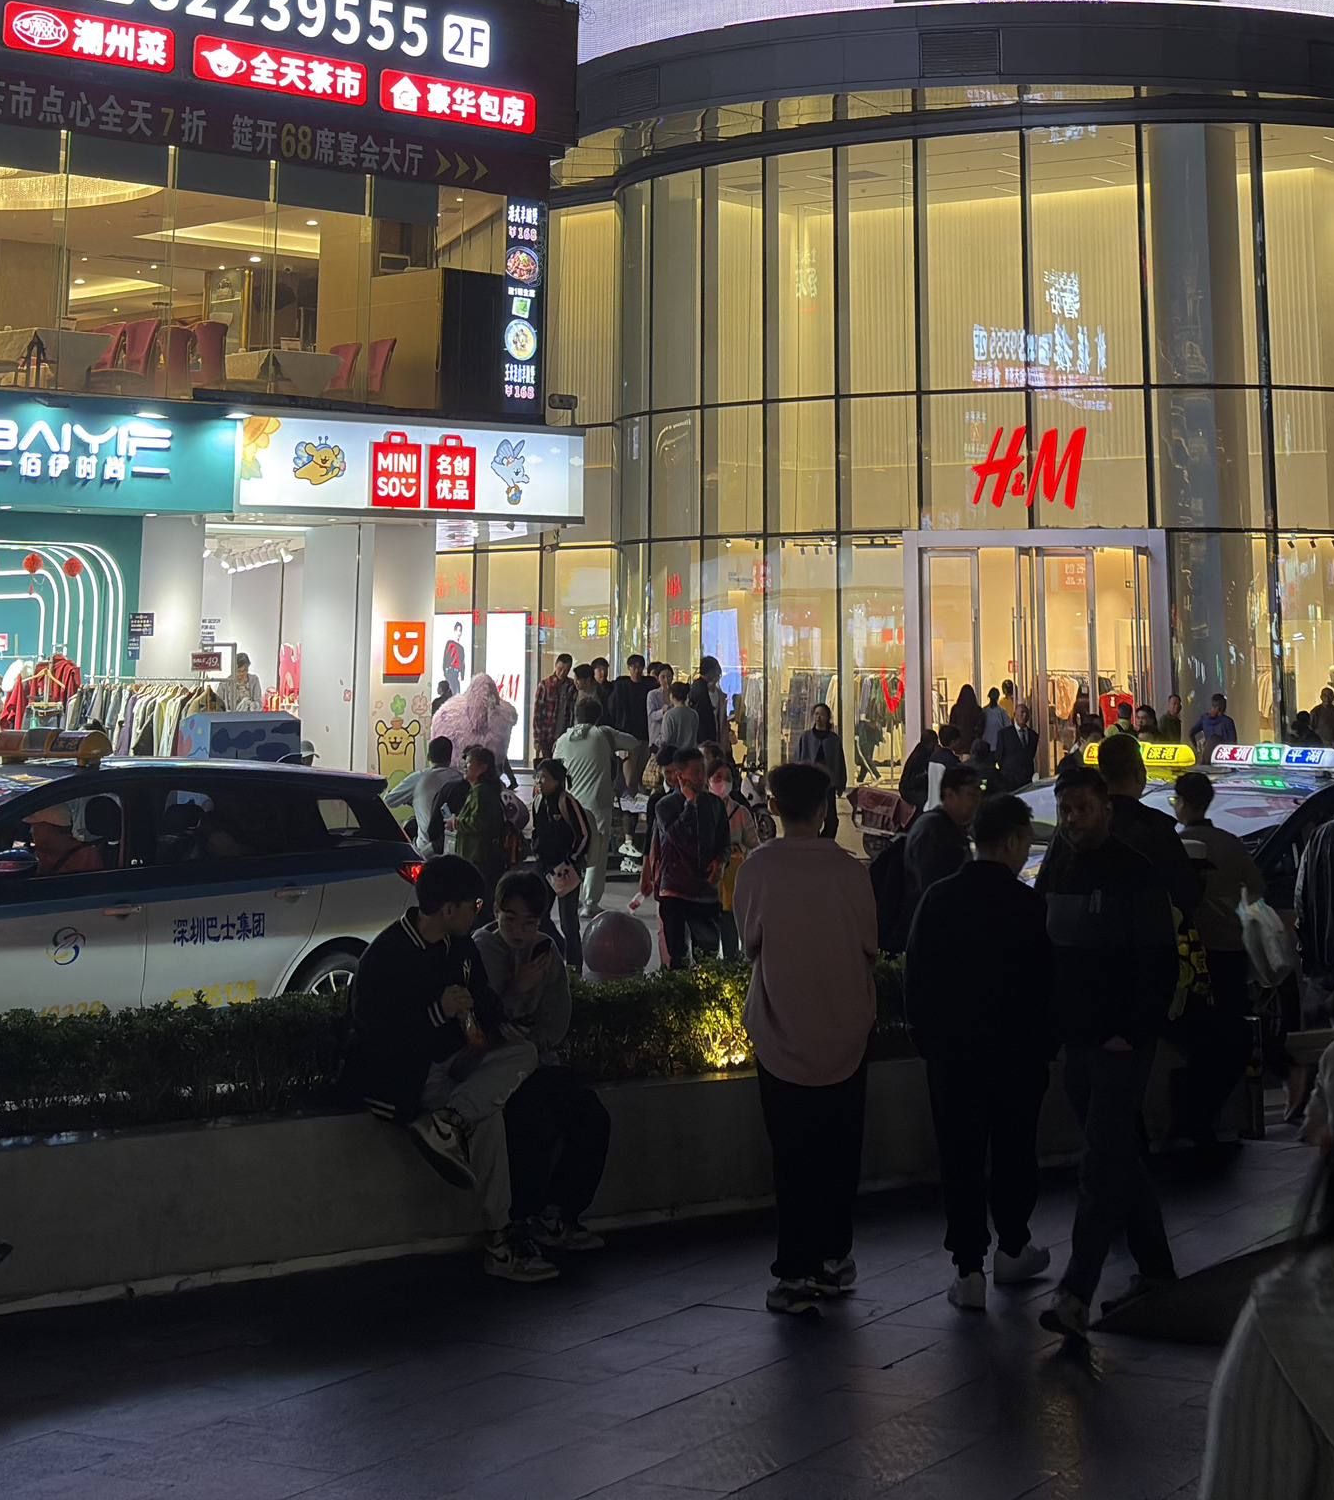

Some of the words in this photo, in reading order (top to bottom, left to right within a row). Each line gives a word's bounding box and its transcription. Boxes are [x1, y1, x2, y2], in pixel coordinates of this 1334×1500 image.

[71, 17, 167, 67] 潮州菜
[446, 20, 486, 58] 2F
[248, 51, 361, 100] 全天茶市
[425, 82, 526, 128] 豪华包房
[231, 113, 424, 178] 筵开68席宴会大厅
[18, 451, 126, 482] 佰伊时尚
[377, 451, 417, 474] MINI
[436, 454, 471, 477] 名创
[971, 425, 1087, 510] H&M
[435, 478, 470, 501] 优品
[1147, 746, 1176, 760] 深港
[1216, 746, 1252, 762] 深圳
[1287, 748, 1322, 763] 平湖
[173, 912, 265, 946] 深圳巴士集团
